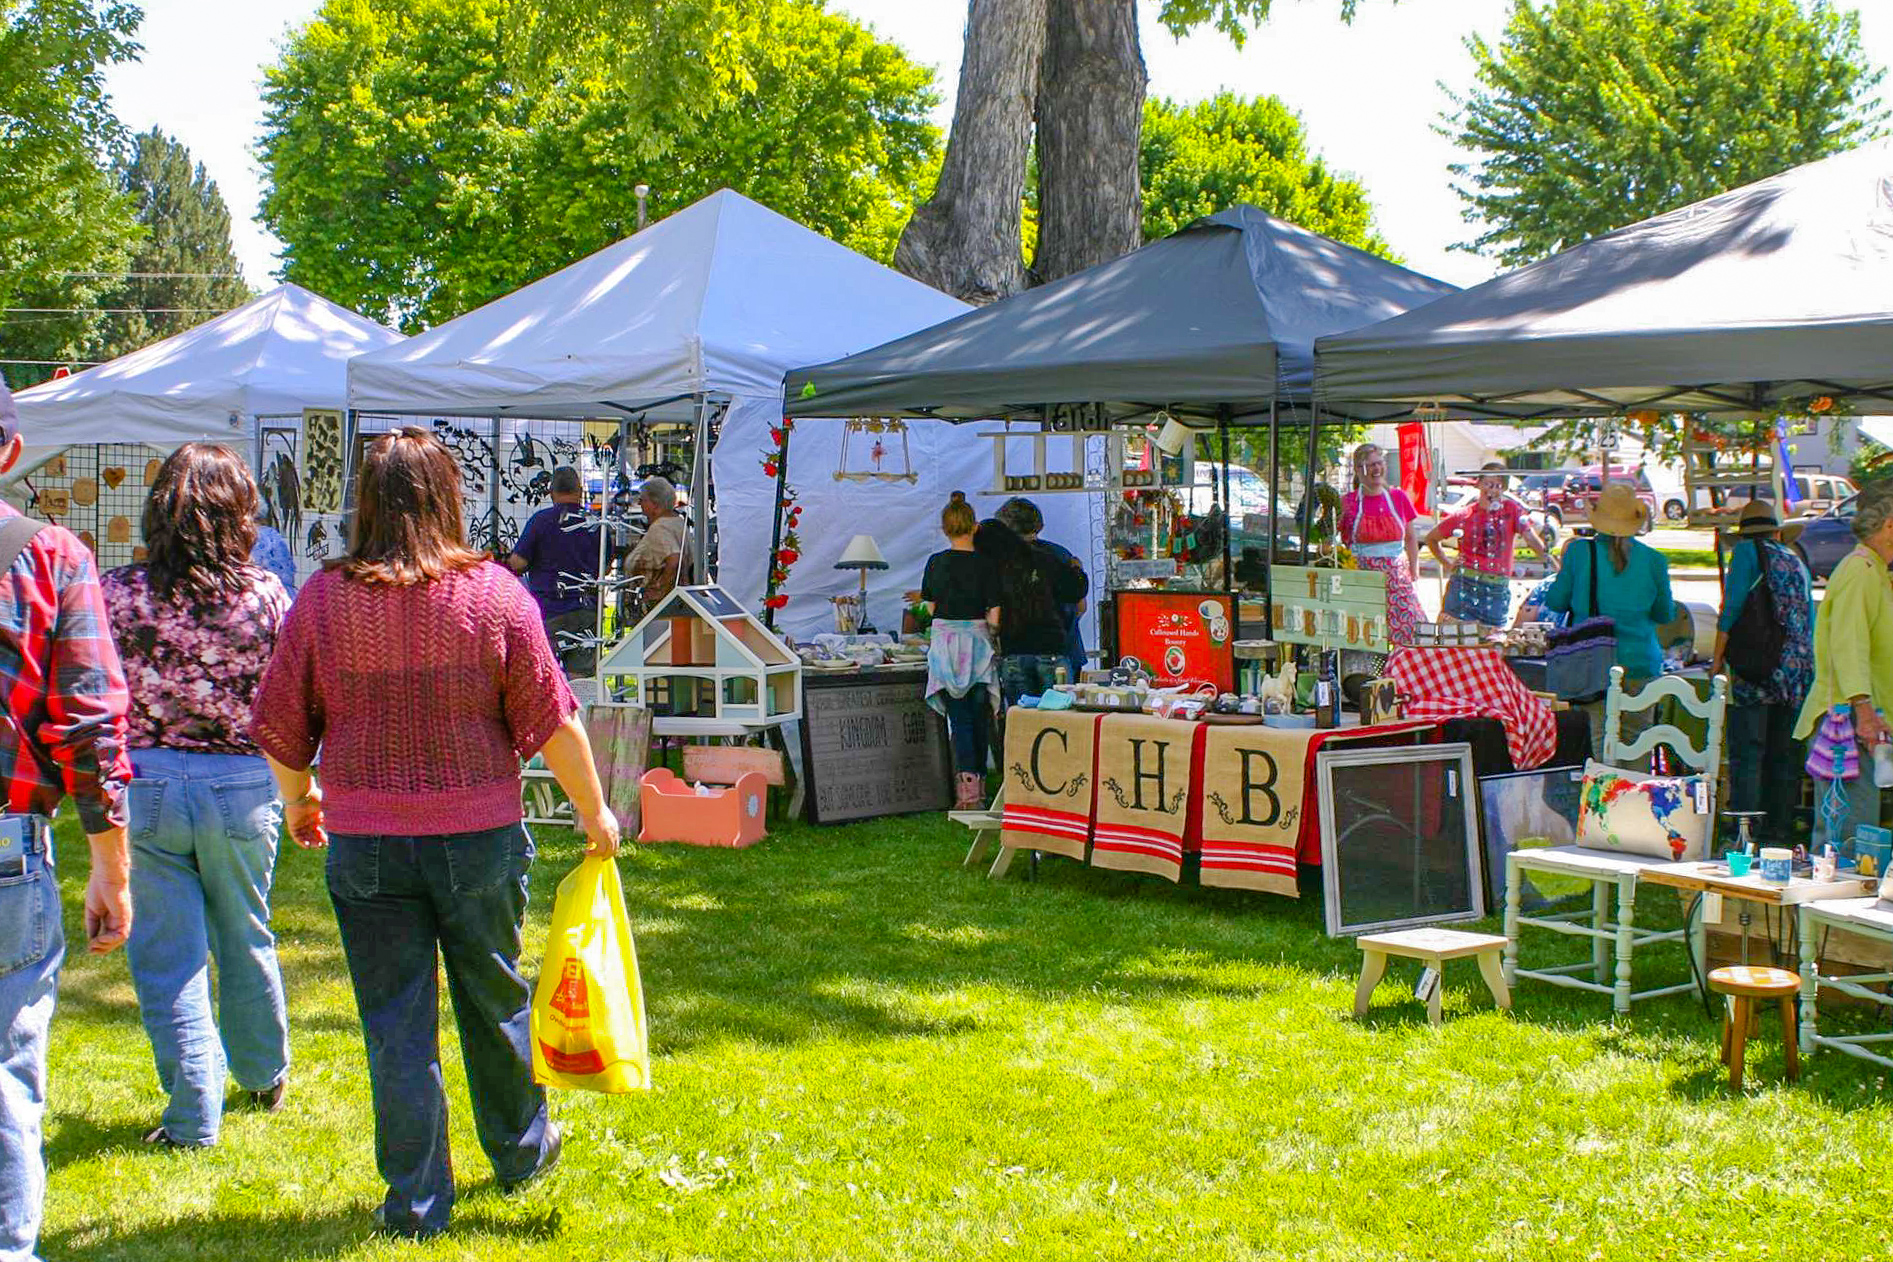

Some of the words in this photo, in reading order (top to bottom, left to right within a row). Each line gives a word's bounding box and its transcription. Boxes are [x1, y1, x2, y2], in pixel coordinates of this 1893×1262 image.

[1306, 571, 1342, 603] THE
[1030, 727, 1068, 795] C
[1128, 738, 1170, 813] H
[1235, 748, 1281, 826] B
